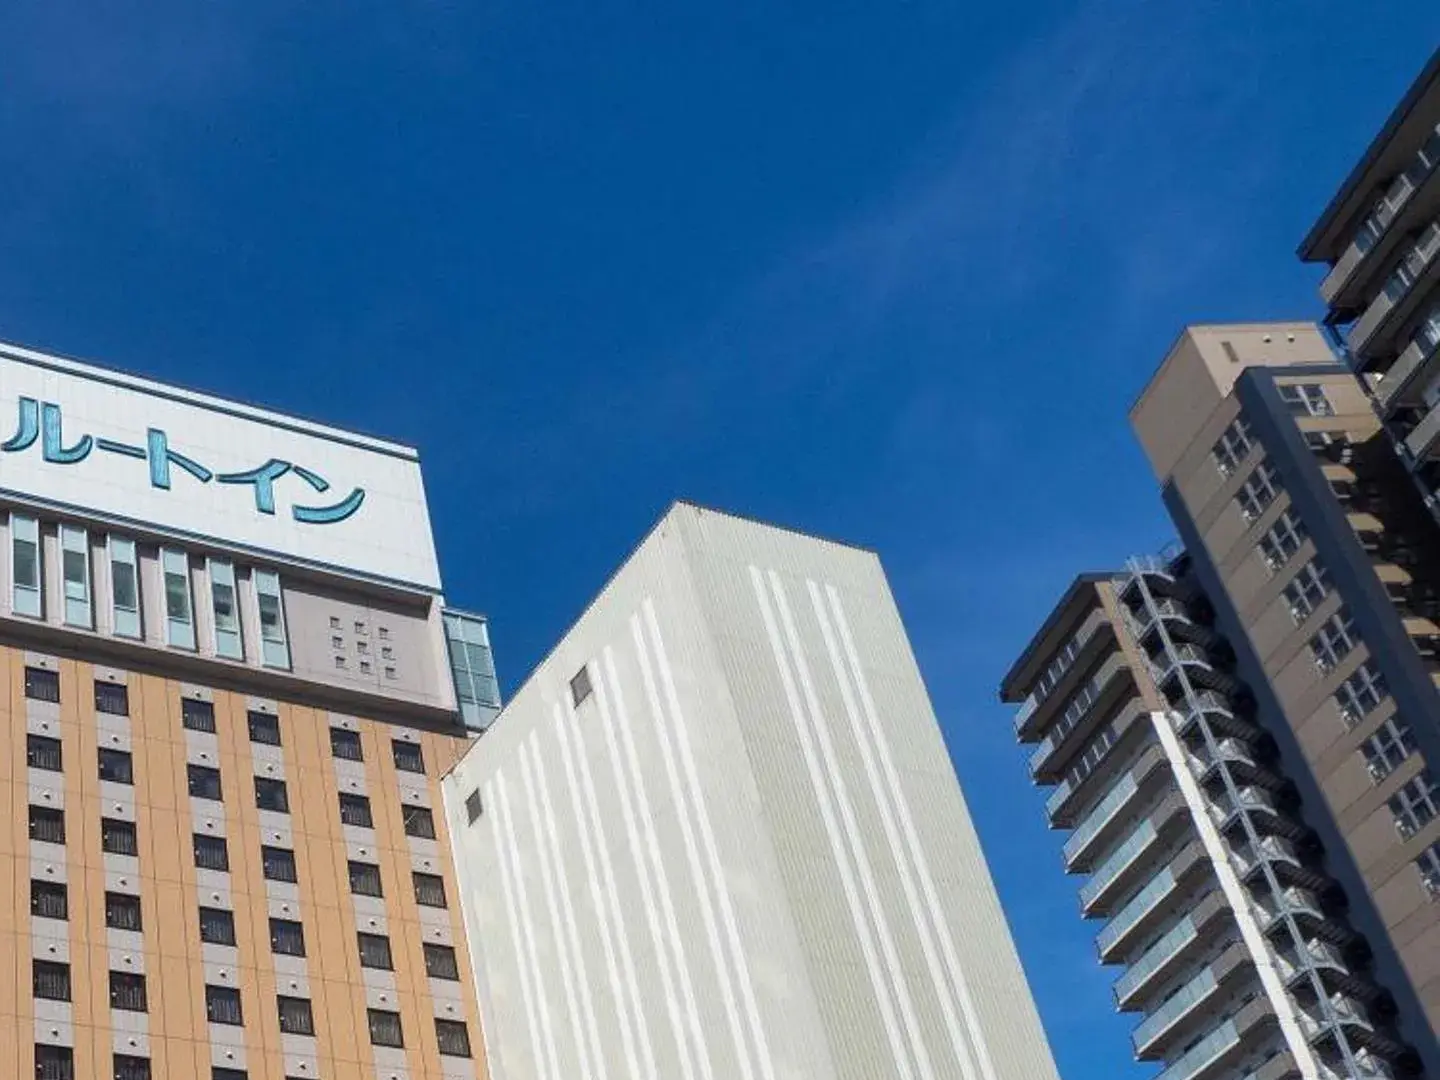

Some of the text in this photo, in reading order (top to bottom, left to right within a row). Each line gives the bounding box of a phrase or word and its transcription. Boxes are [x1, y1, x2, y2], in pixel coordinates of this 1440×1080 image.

[0, 396, 366, 525] ルートイン
